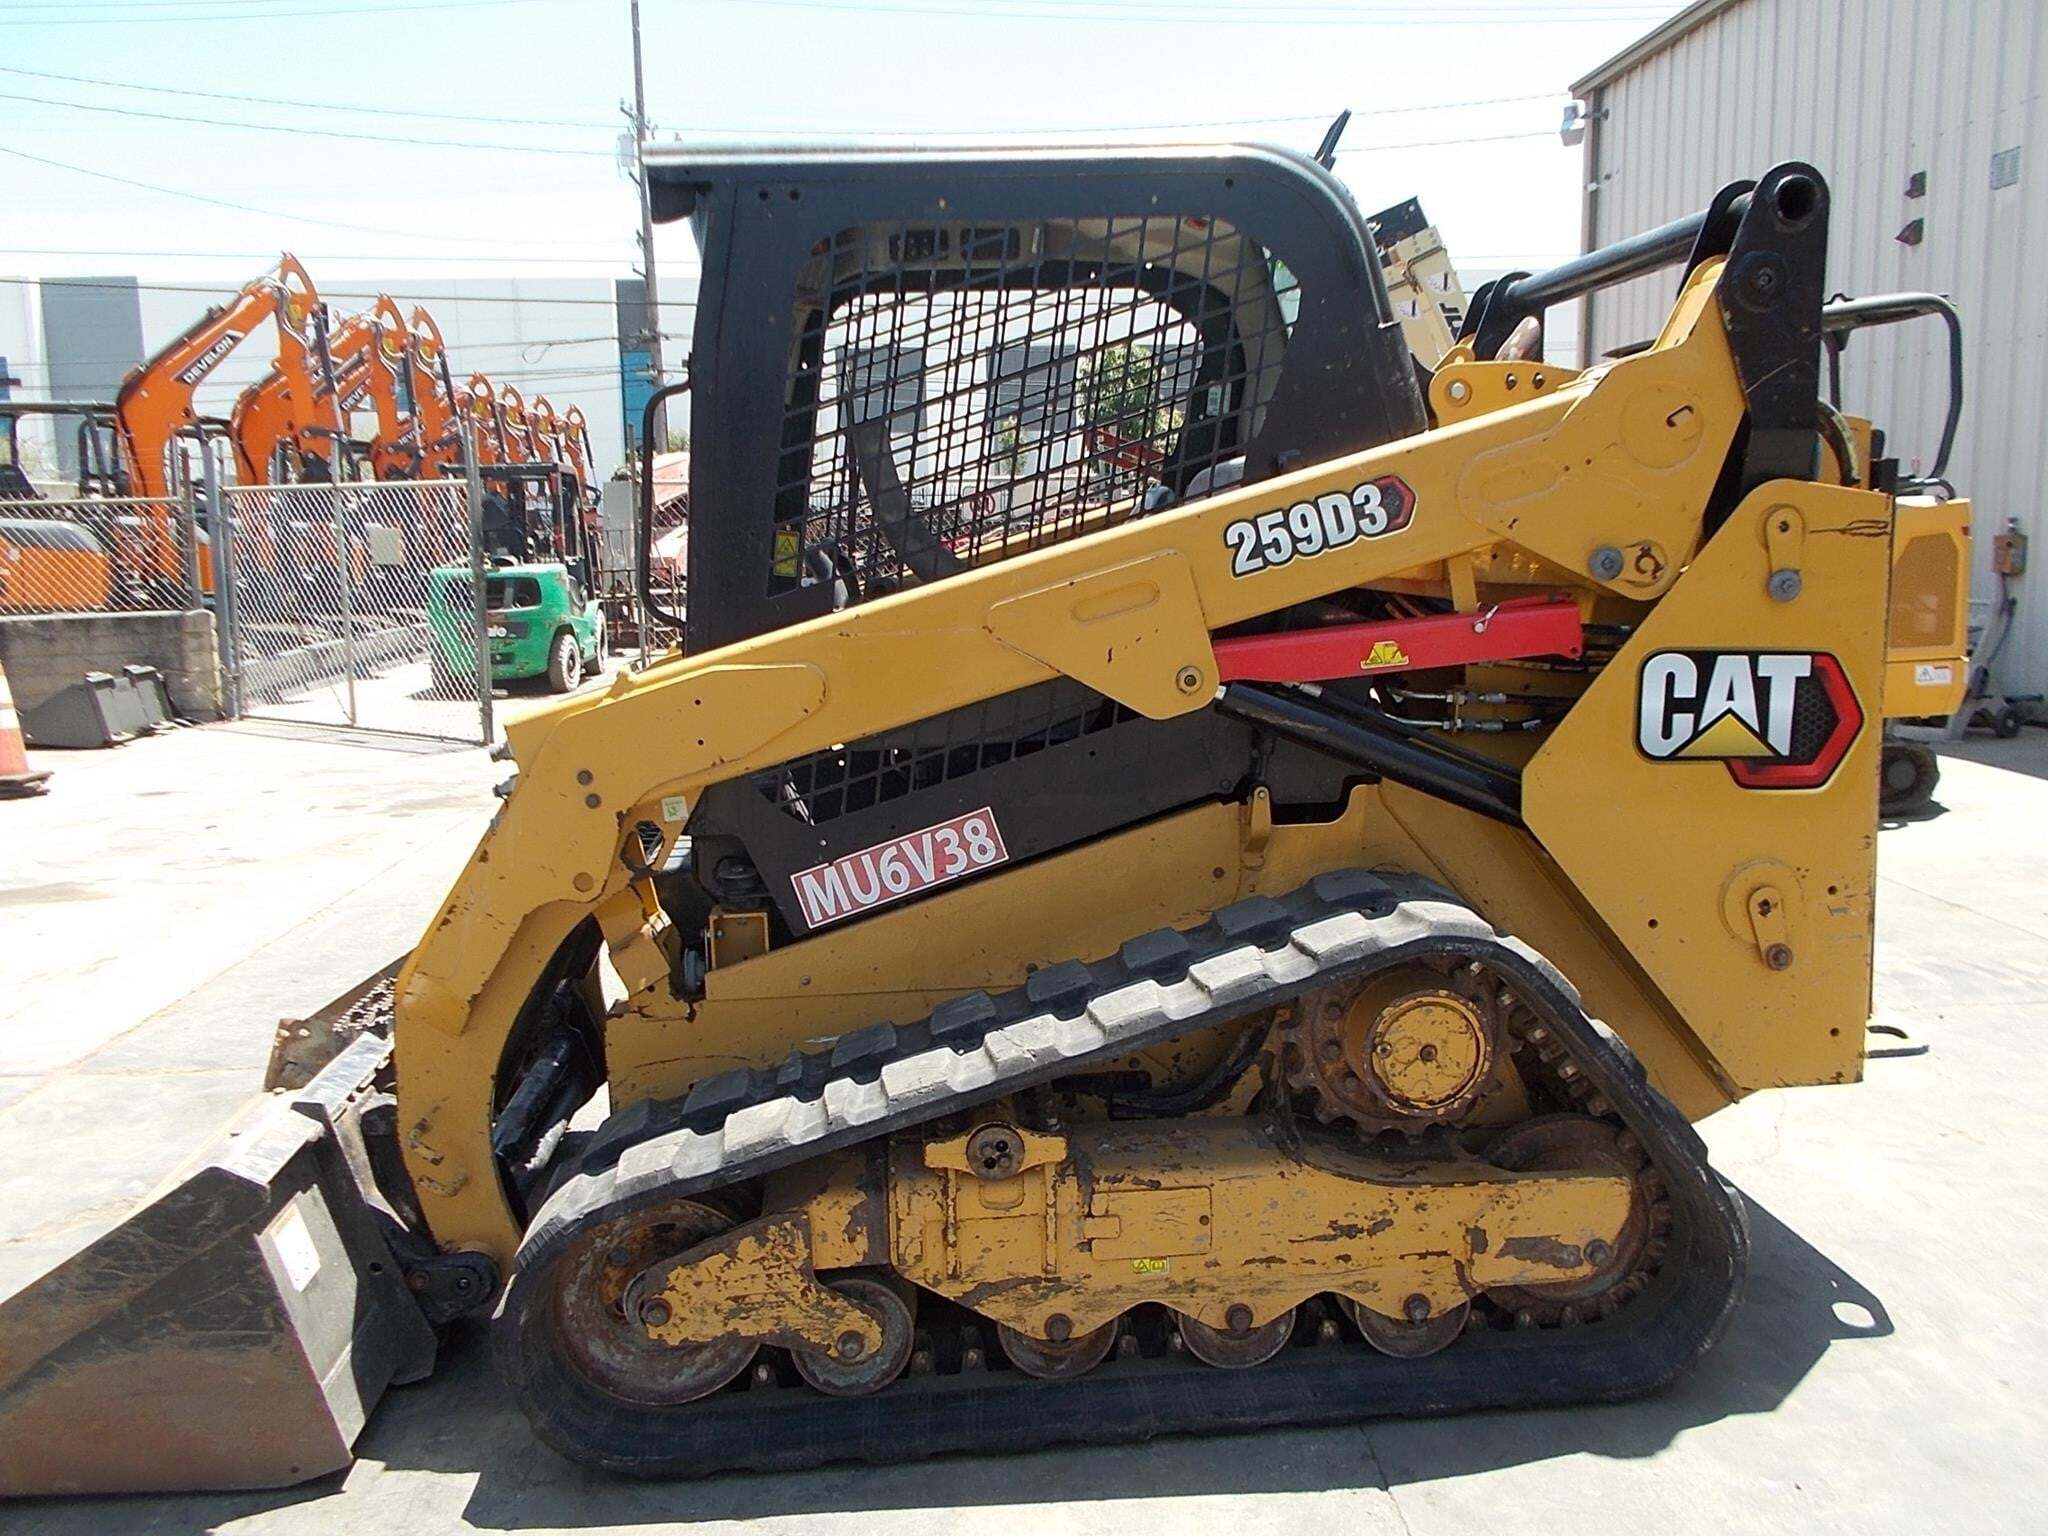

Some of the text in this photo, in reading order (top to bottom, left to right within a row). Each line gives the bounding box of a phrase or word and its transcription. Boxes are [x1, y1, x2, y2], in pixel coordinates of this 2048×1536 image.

[183, 335, 235, 384] DEVELON
[1225, 483, 1388, 575] 259D3
[1639, 652, 1812, 758] CAT
[801, 818, 997, 922] MU6V38
